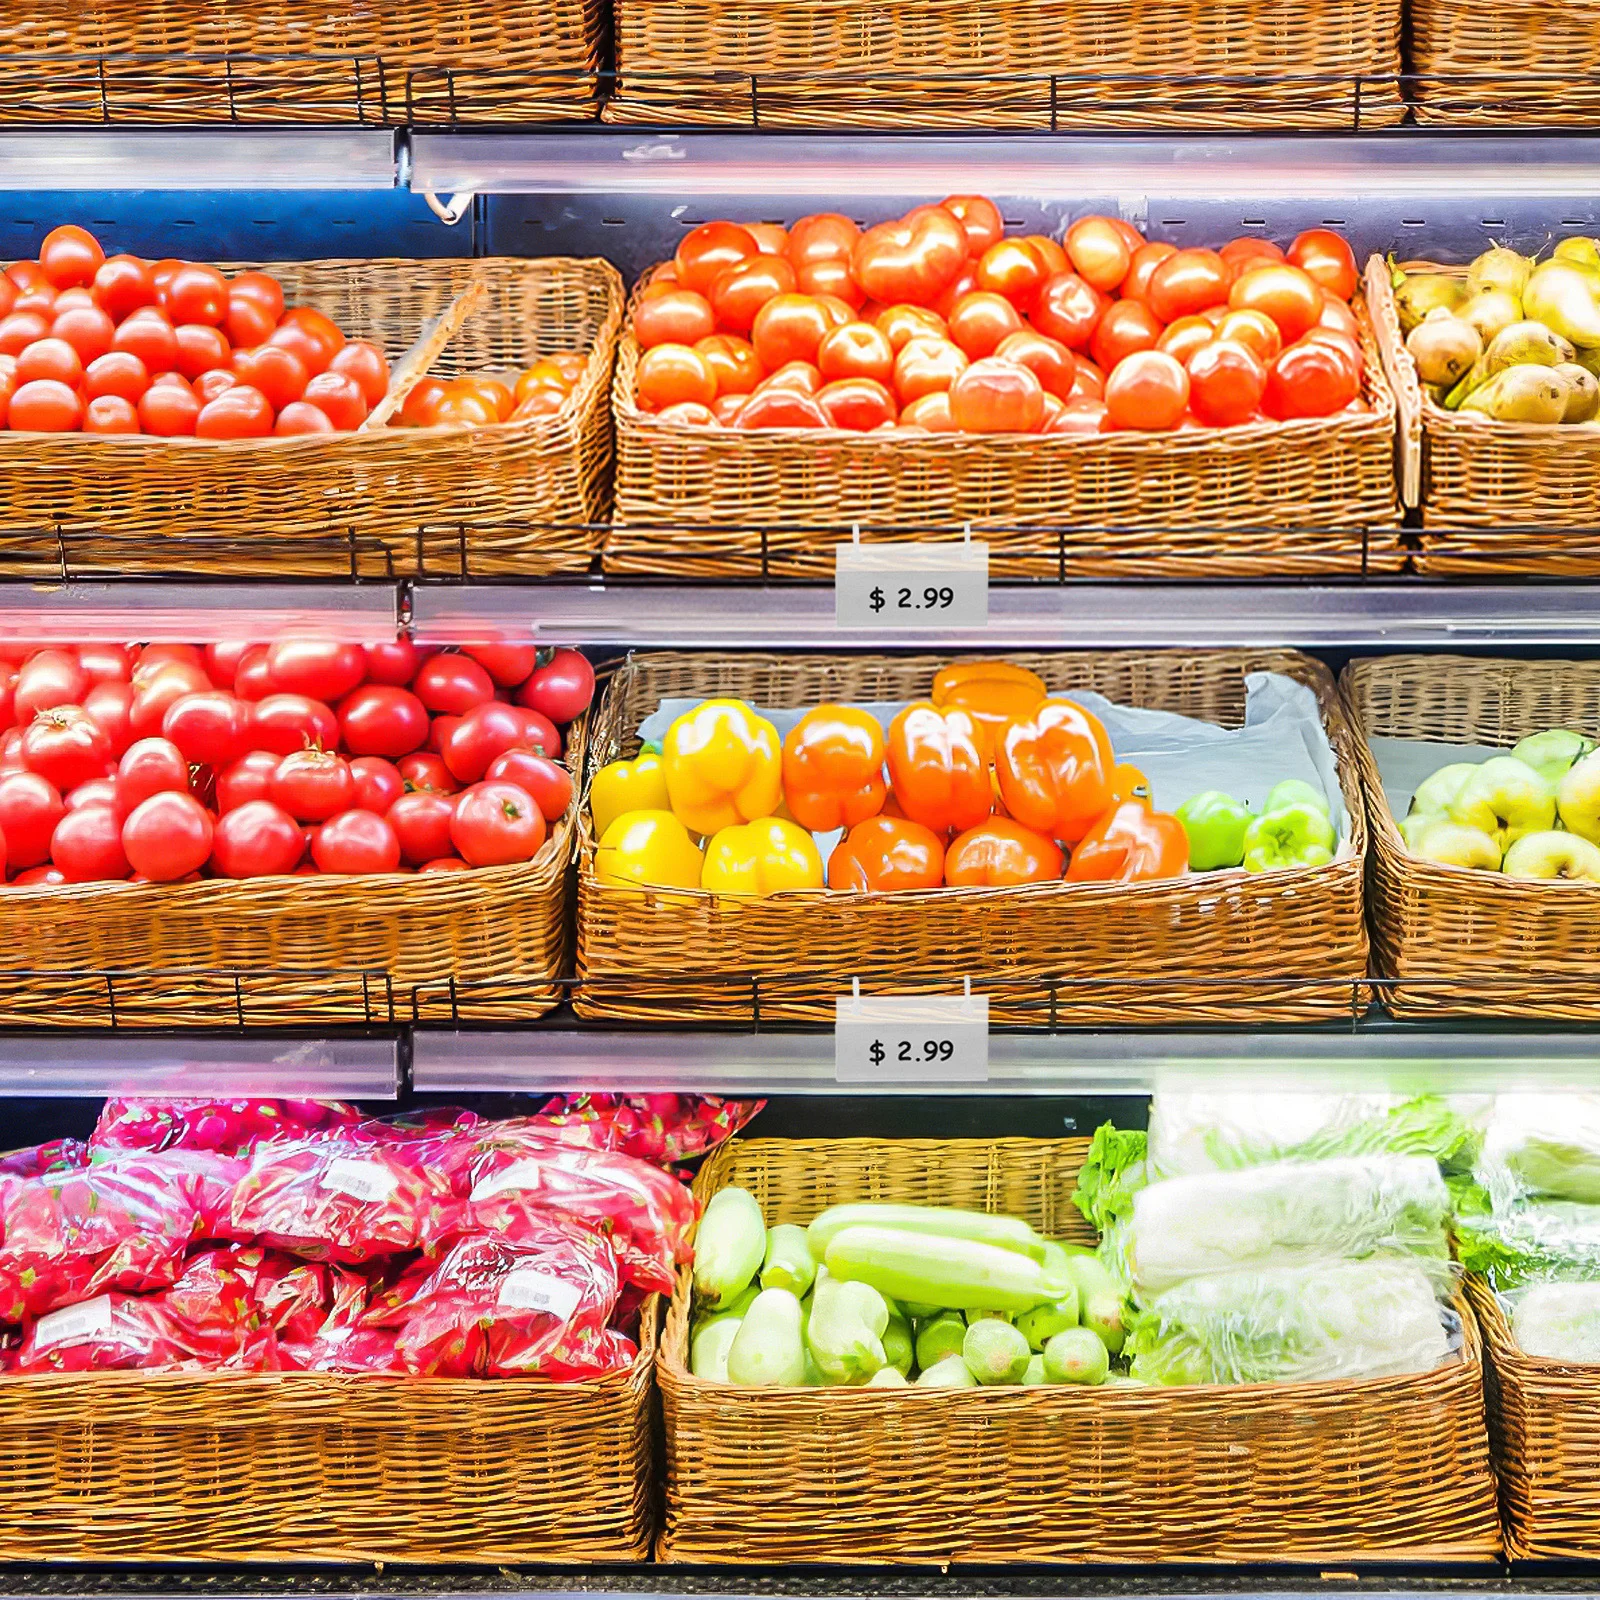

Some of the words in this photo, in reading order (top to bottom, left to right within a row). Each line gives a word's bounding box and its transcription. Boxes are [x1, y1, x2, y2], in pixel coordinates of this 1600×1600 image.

[869, 586, 886, 613] $
[898, 587, 954, 609] 2.99
[869, 1039, 886, 1066] $
[898, 1040, 954, 1062] 2.99
